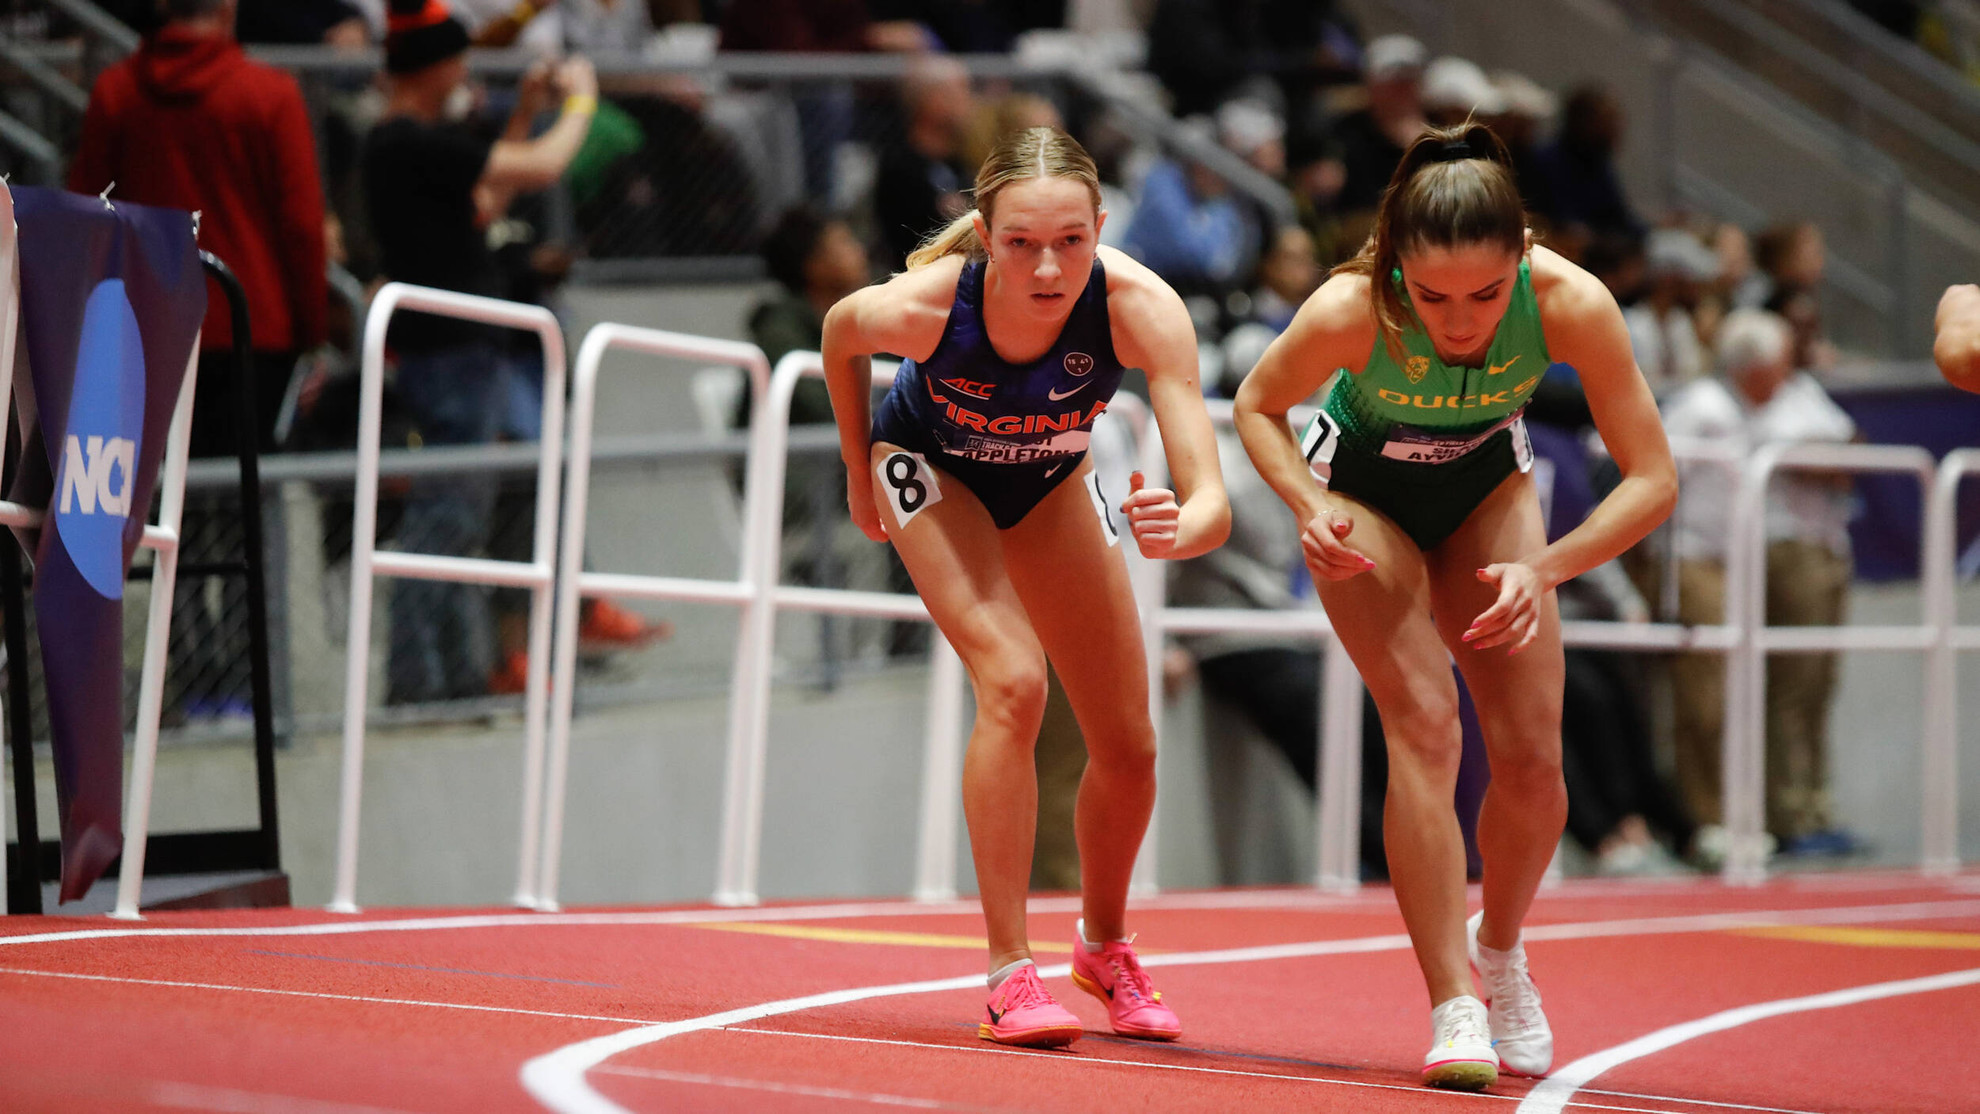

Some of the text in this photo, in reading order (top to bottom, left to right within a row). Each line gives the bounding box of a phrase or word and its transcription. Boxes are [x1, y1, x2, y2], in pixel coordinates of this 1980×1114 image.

[944, 377, 997, 397] ACC
[1378, 375, 1538, 409] DUCKS
[886, 453, 927, 513] 8
